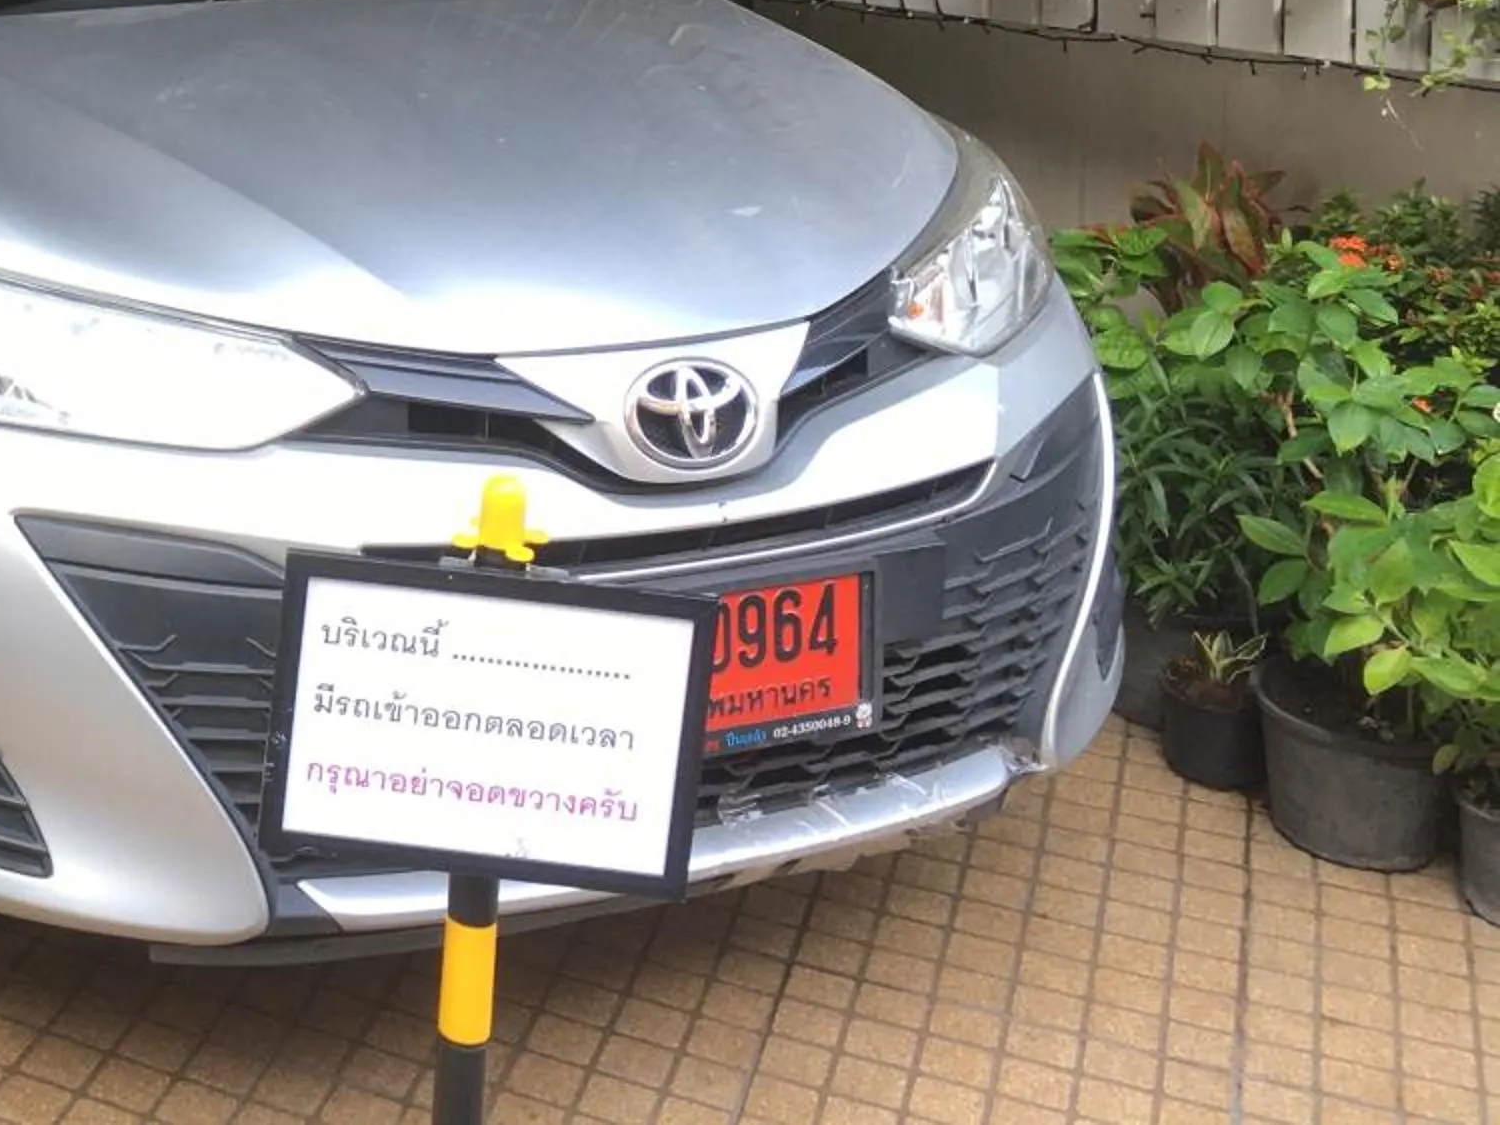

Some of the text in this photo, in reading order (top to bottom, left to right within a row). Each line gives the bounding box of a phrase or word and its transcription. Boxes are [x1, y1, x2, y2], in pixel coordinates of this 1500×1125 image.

[320, 615, 450, 658] บริเวณนี้
[707, 579, 838, 675] 0964
[313, 682, 635, 751] มีรถเข้าออกตลอดเวลา
[306, 761, 638, 822] กรุณาอย่าจอดขวางครับ
